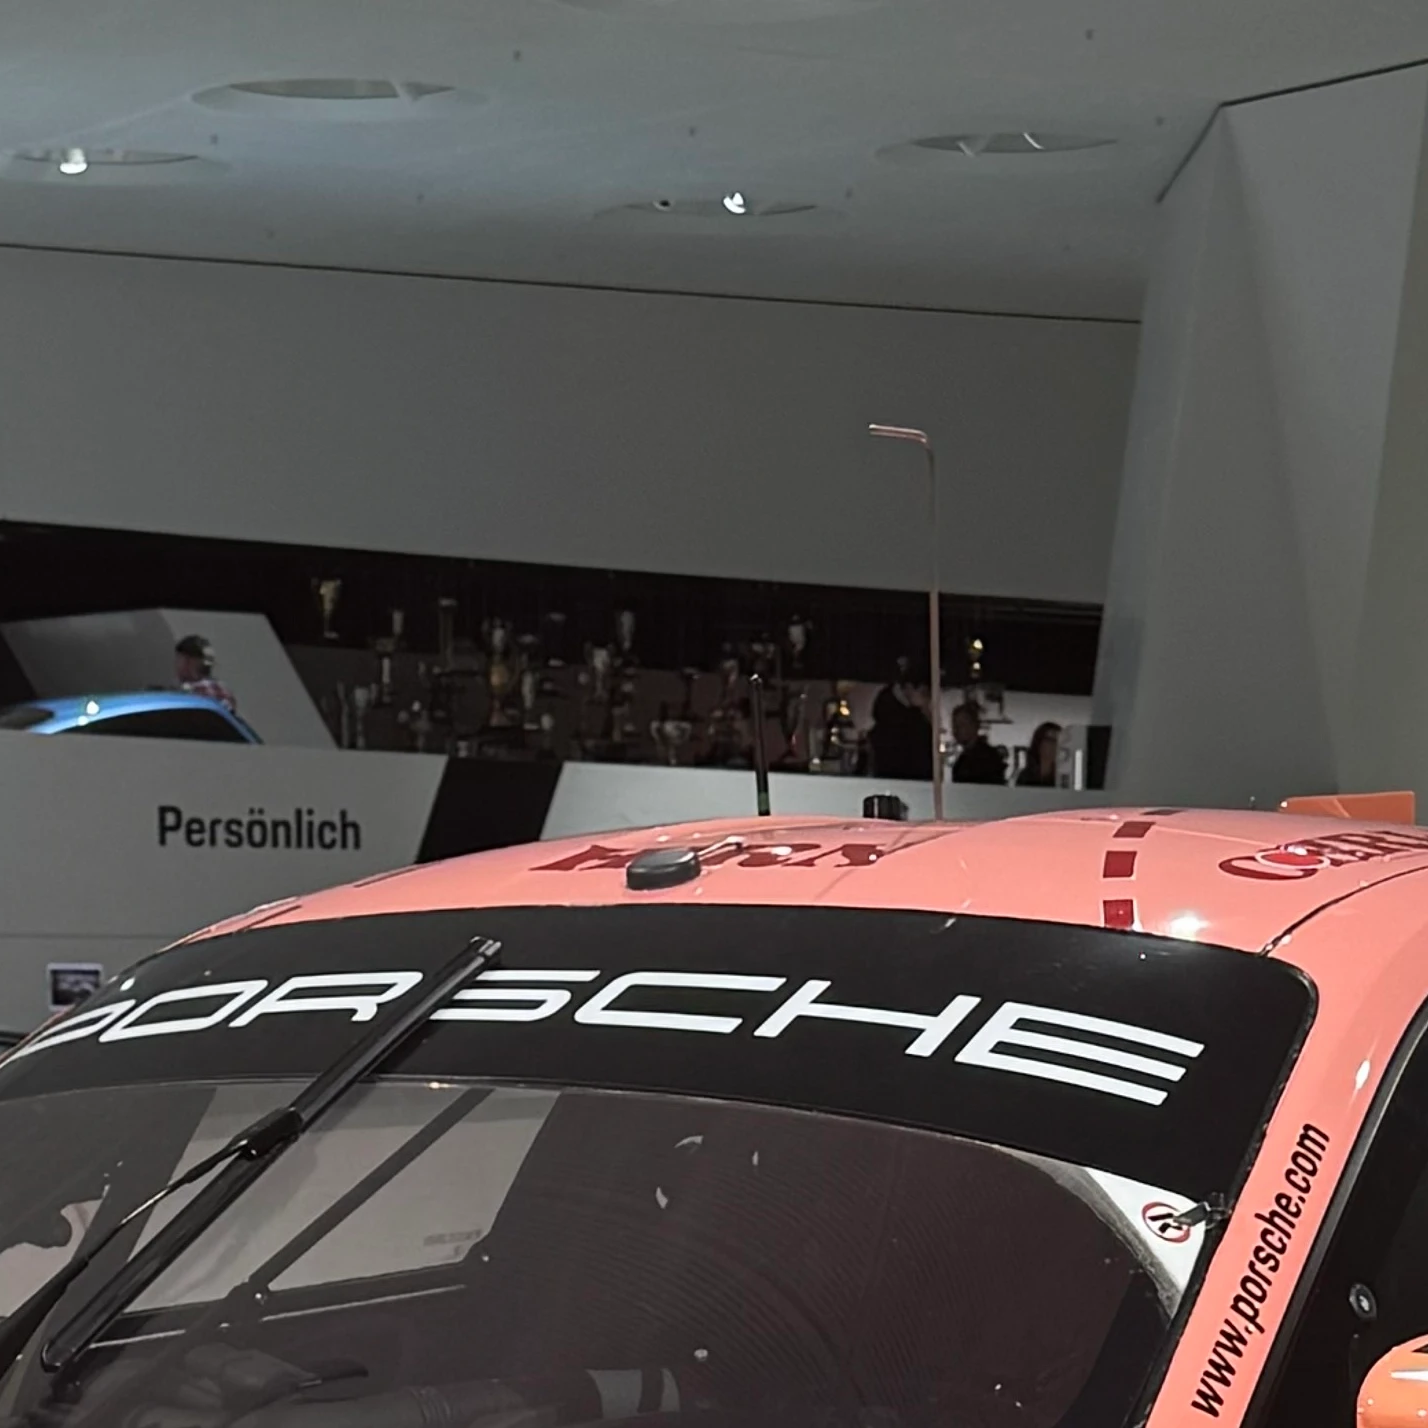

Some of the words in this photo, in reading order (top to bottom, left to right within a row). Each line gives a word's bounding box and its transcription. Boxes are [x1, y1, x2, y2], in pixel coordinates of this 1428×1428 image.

[157, 804, 362, 851] Persönlich
[4, 969, 1205, 1107] PORSCHE
[1190, 1122, 1330, 1419] www.porsche.com
